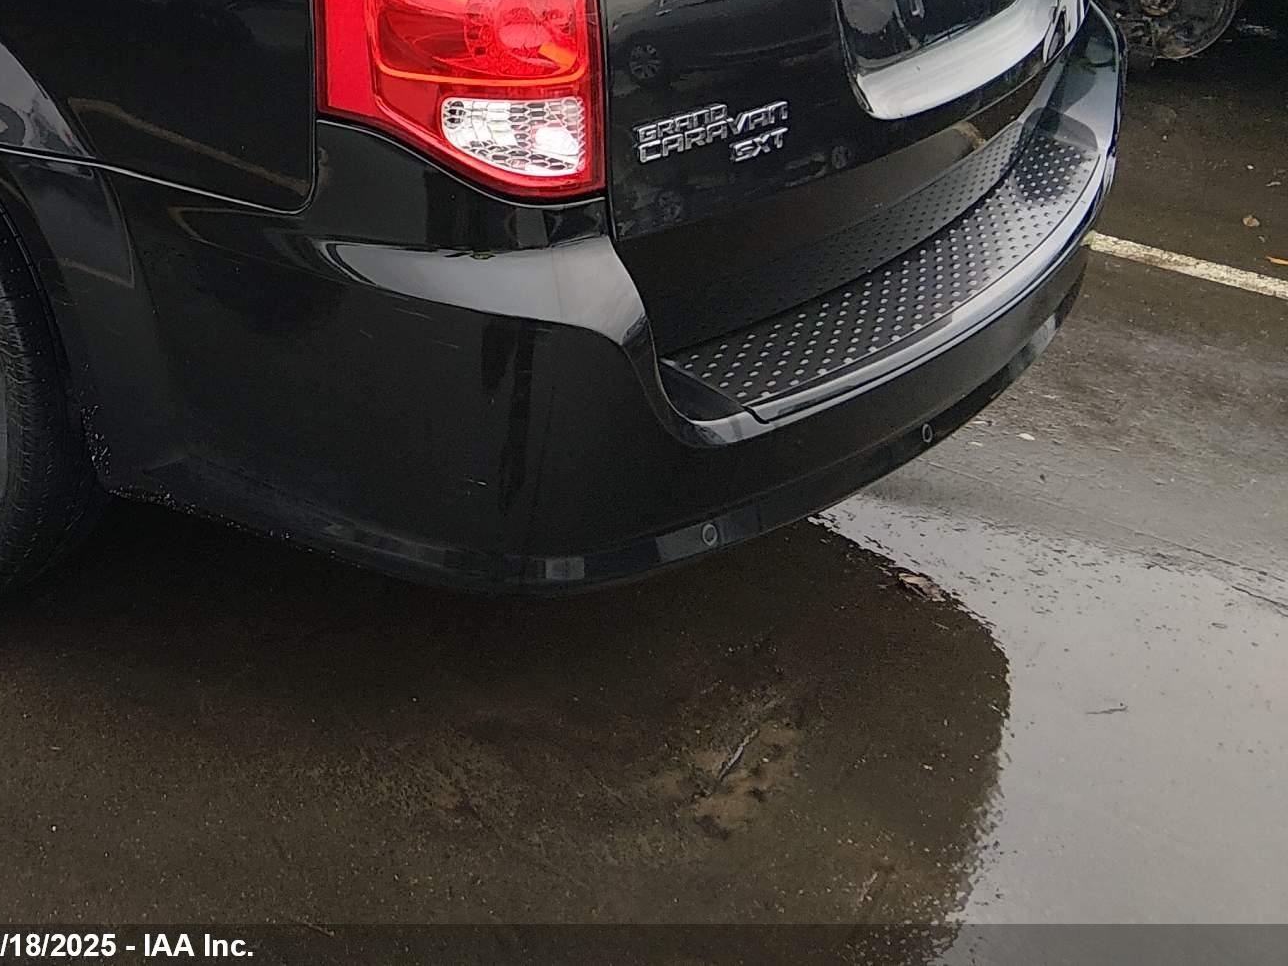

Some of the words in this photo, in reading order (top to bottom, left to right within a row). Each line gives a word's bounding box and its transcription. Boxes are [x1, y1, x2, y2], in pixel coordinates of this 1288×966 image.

[634, 104, 728, 143] GRAND
[637, 101, 788, 163] CARAVAN
[730, 127, 788, 162] SXT
